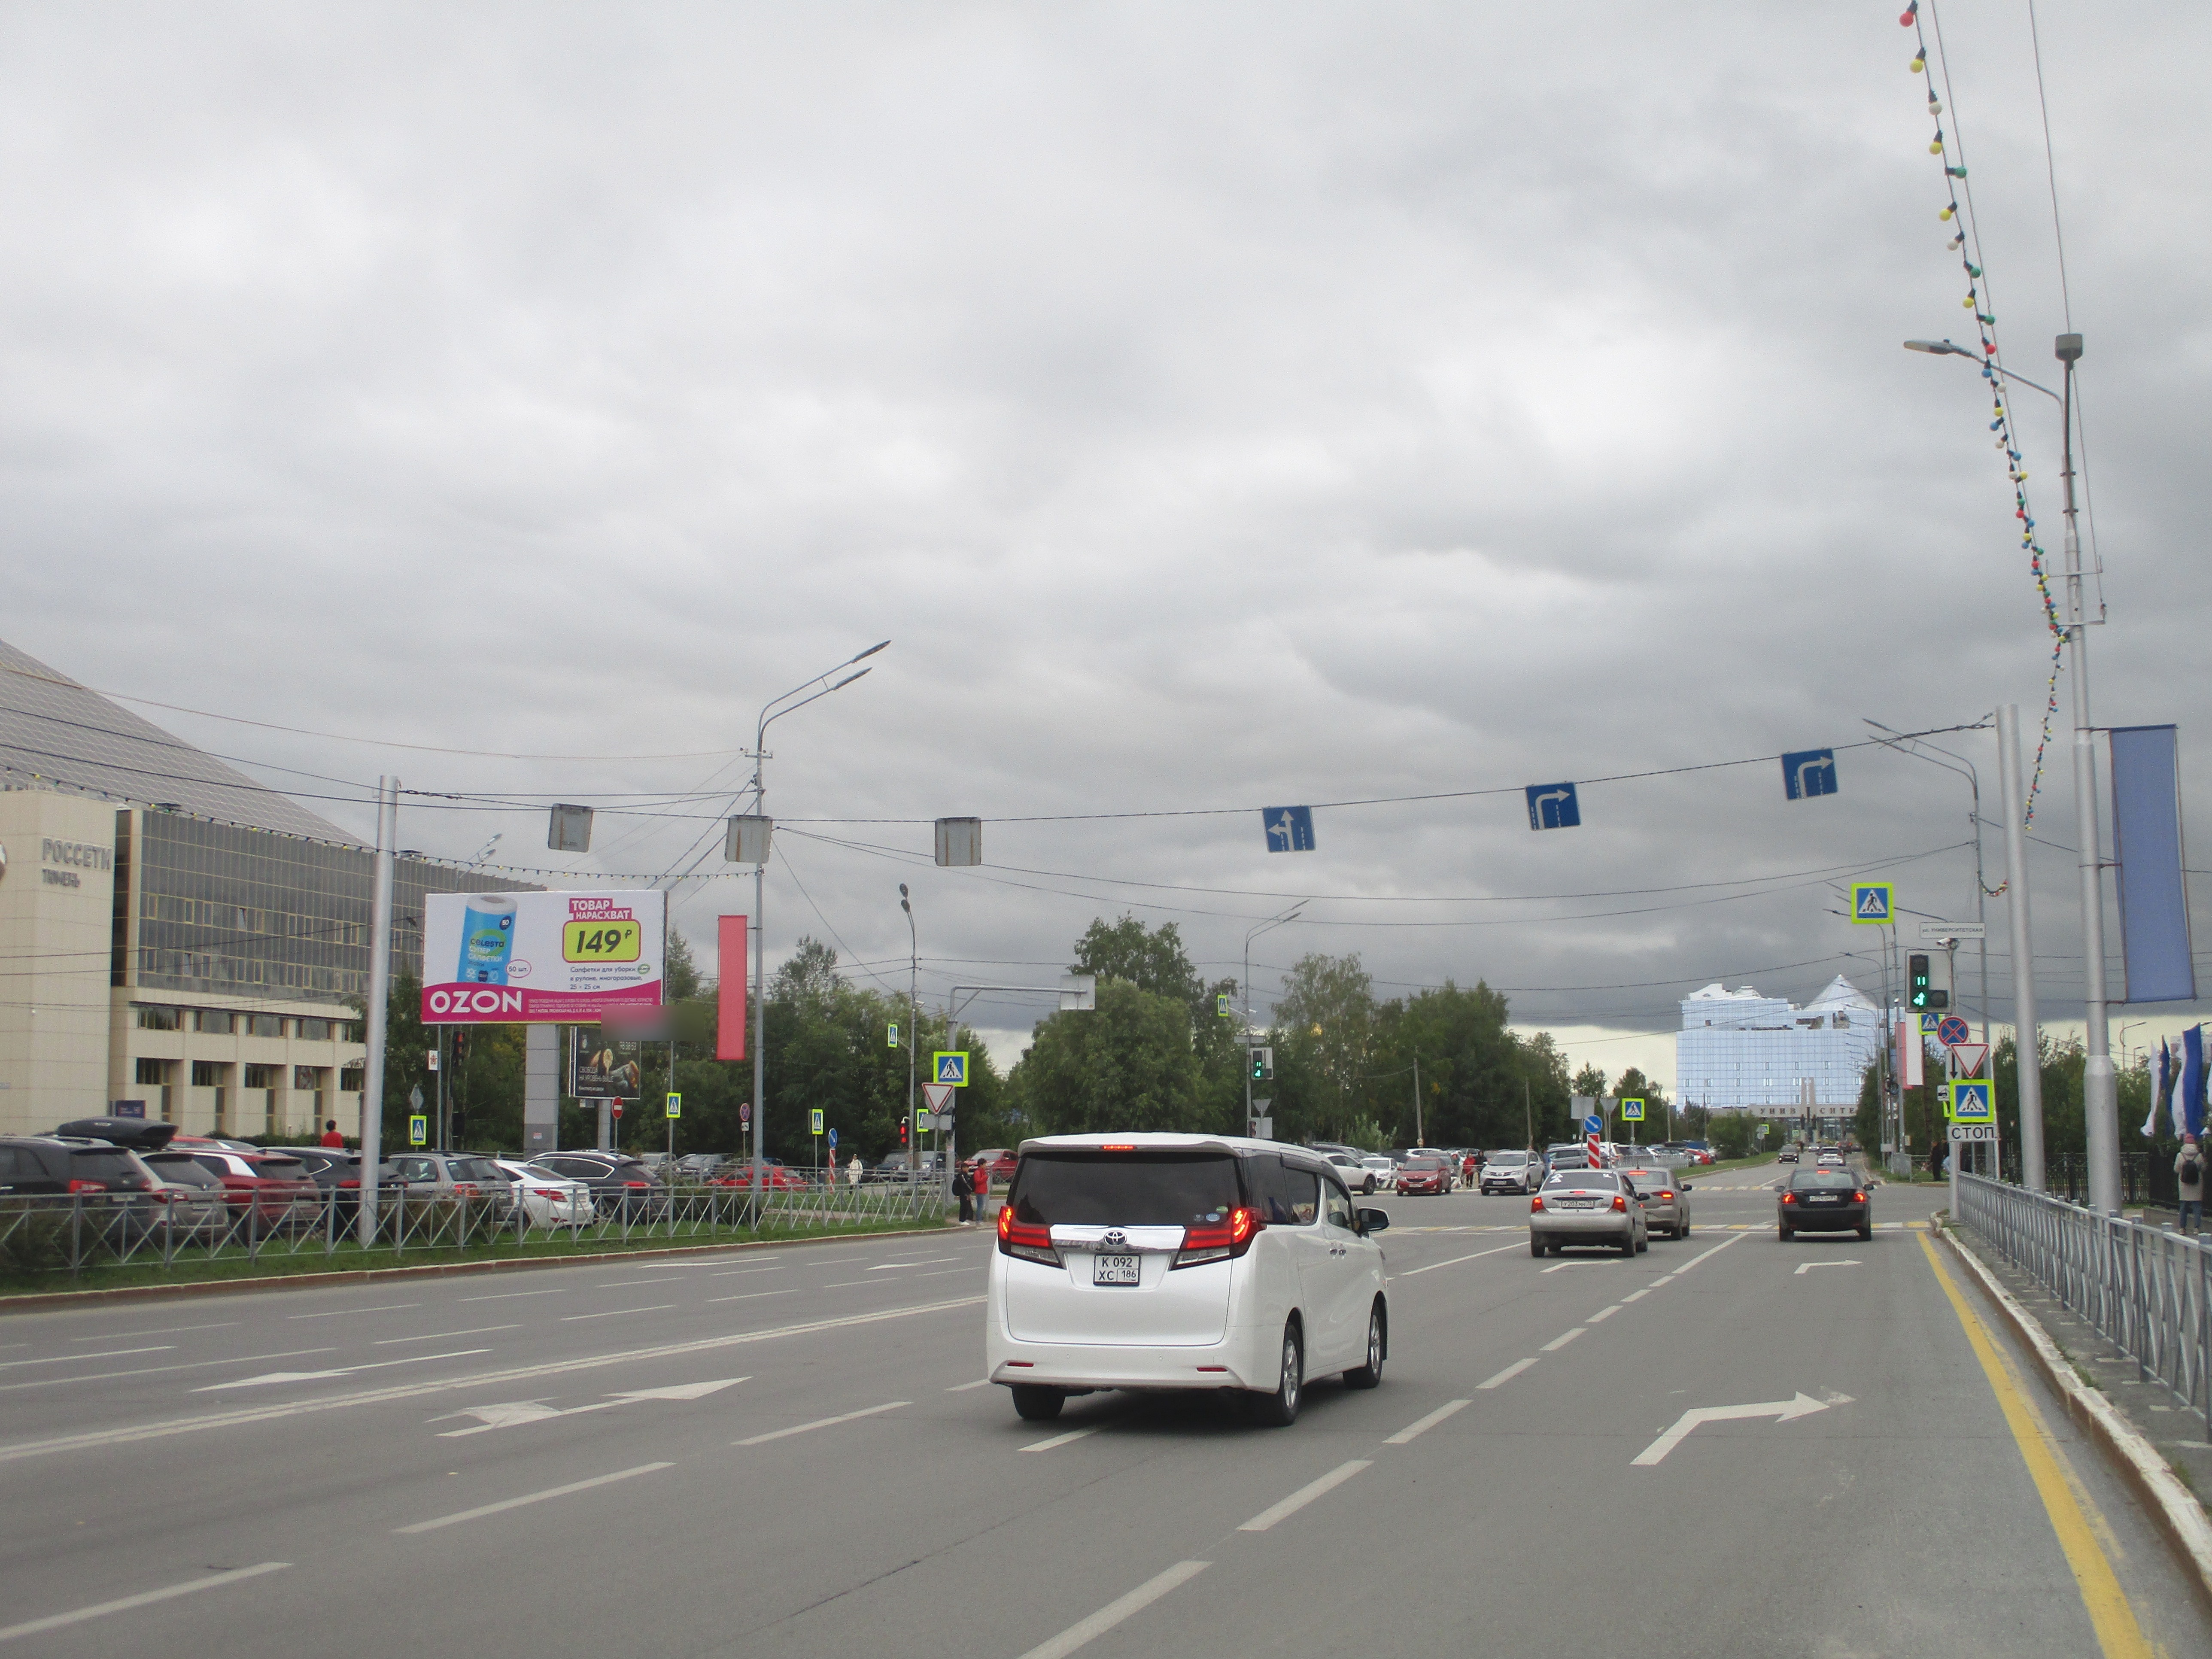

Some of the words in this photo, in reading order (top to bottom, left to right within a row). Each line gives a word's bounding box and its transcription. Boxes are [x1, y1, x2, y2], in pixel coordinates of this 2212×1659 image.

[42, 838, 112, 869] РОССЕТИ
[571, 900, 610, 911] ТОВАР
[576, 910, 629, 919] НАРАСХВАТ
[577, 930, 621, 953] 149
[430, 990, 522, 1014] OZON
[1102, 1257, 1109, 1267] К
[1113, 1257, 1132, 1267] 092
[1099, 1270, 1114, 1280] ХС
[1121, 1270, 1136, 1278] 186
